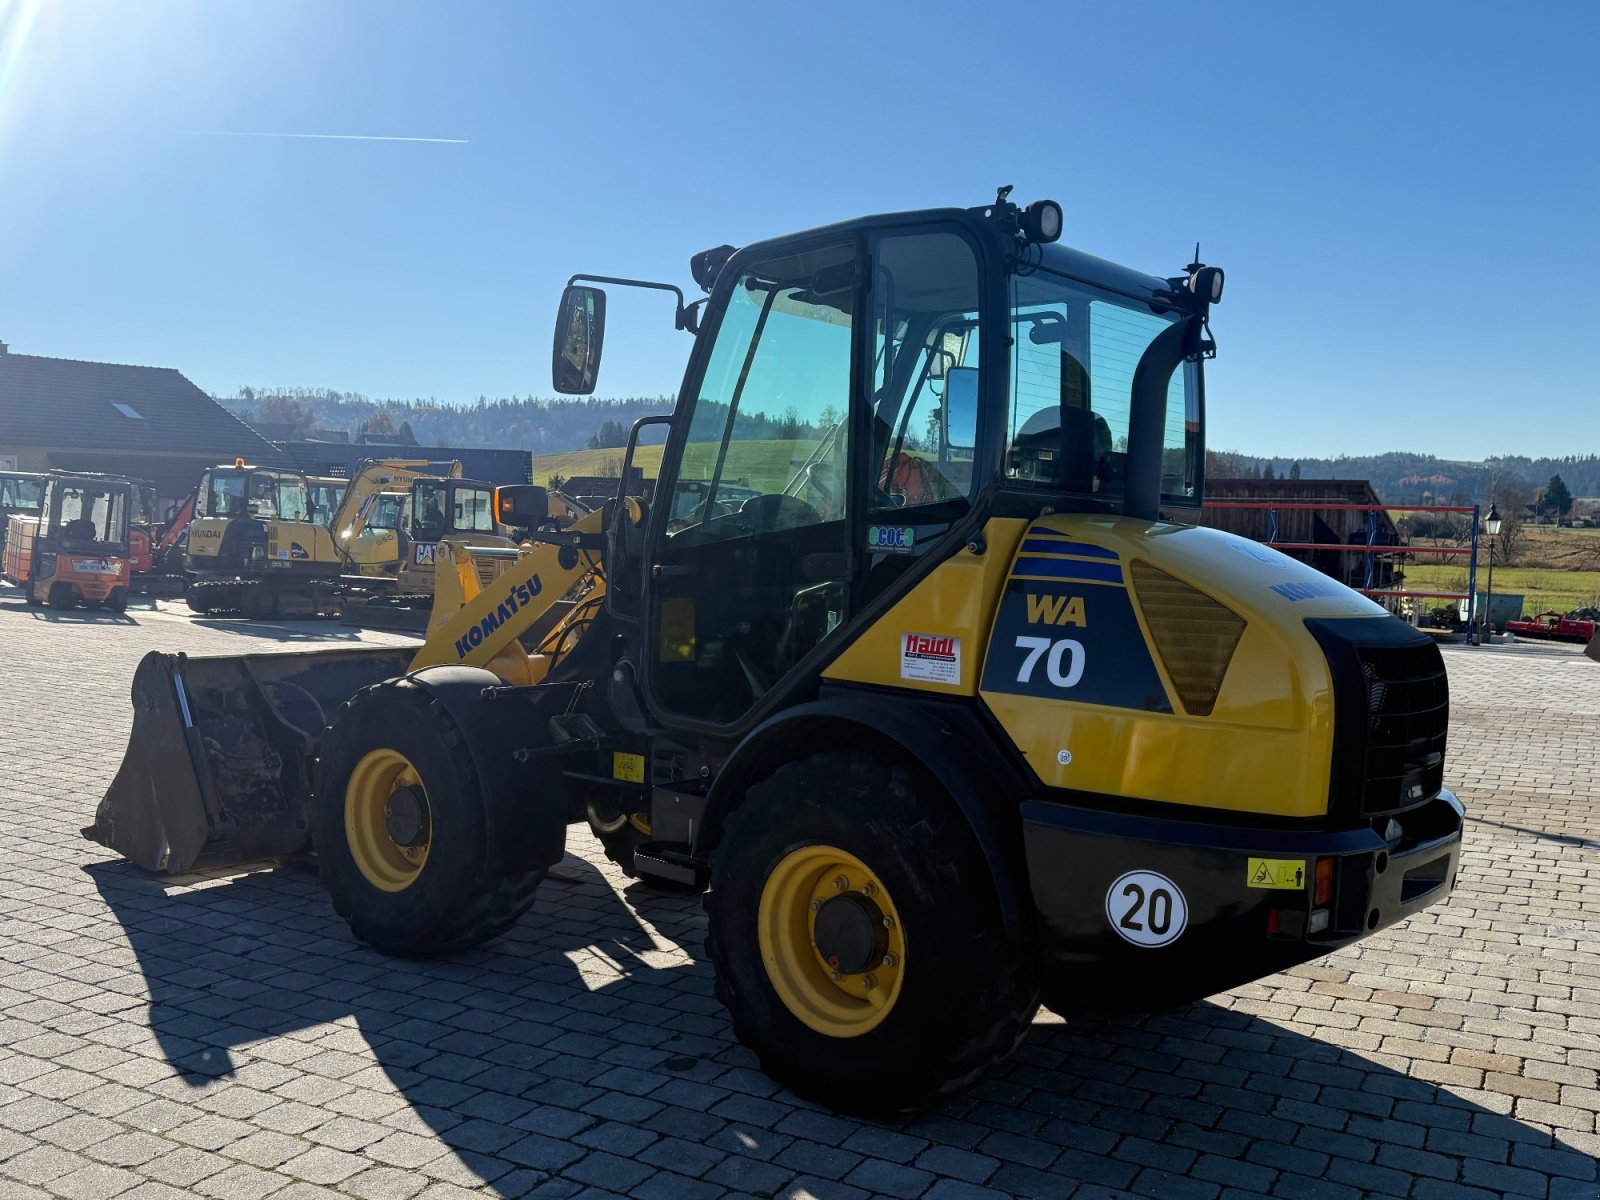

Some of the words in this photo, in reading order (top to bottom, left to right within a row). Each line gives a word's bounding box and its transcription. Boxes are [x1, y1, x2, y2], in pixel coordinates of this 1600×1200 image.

[190, 529, 221, 538] HYUNDAI
[454, 573, 542, 659] KOMATSU
[1026, 593, 1087, 627] WA
[1015, 635, 1086, 688] 70
[1120, 883, 1173, 935] 20
